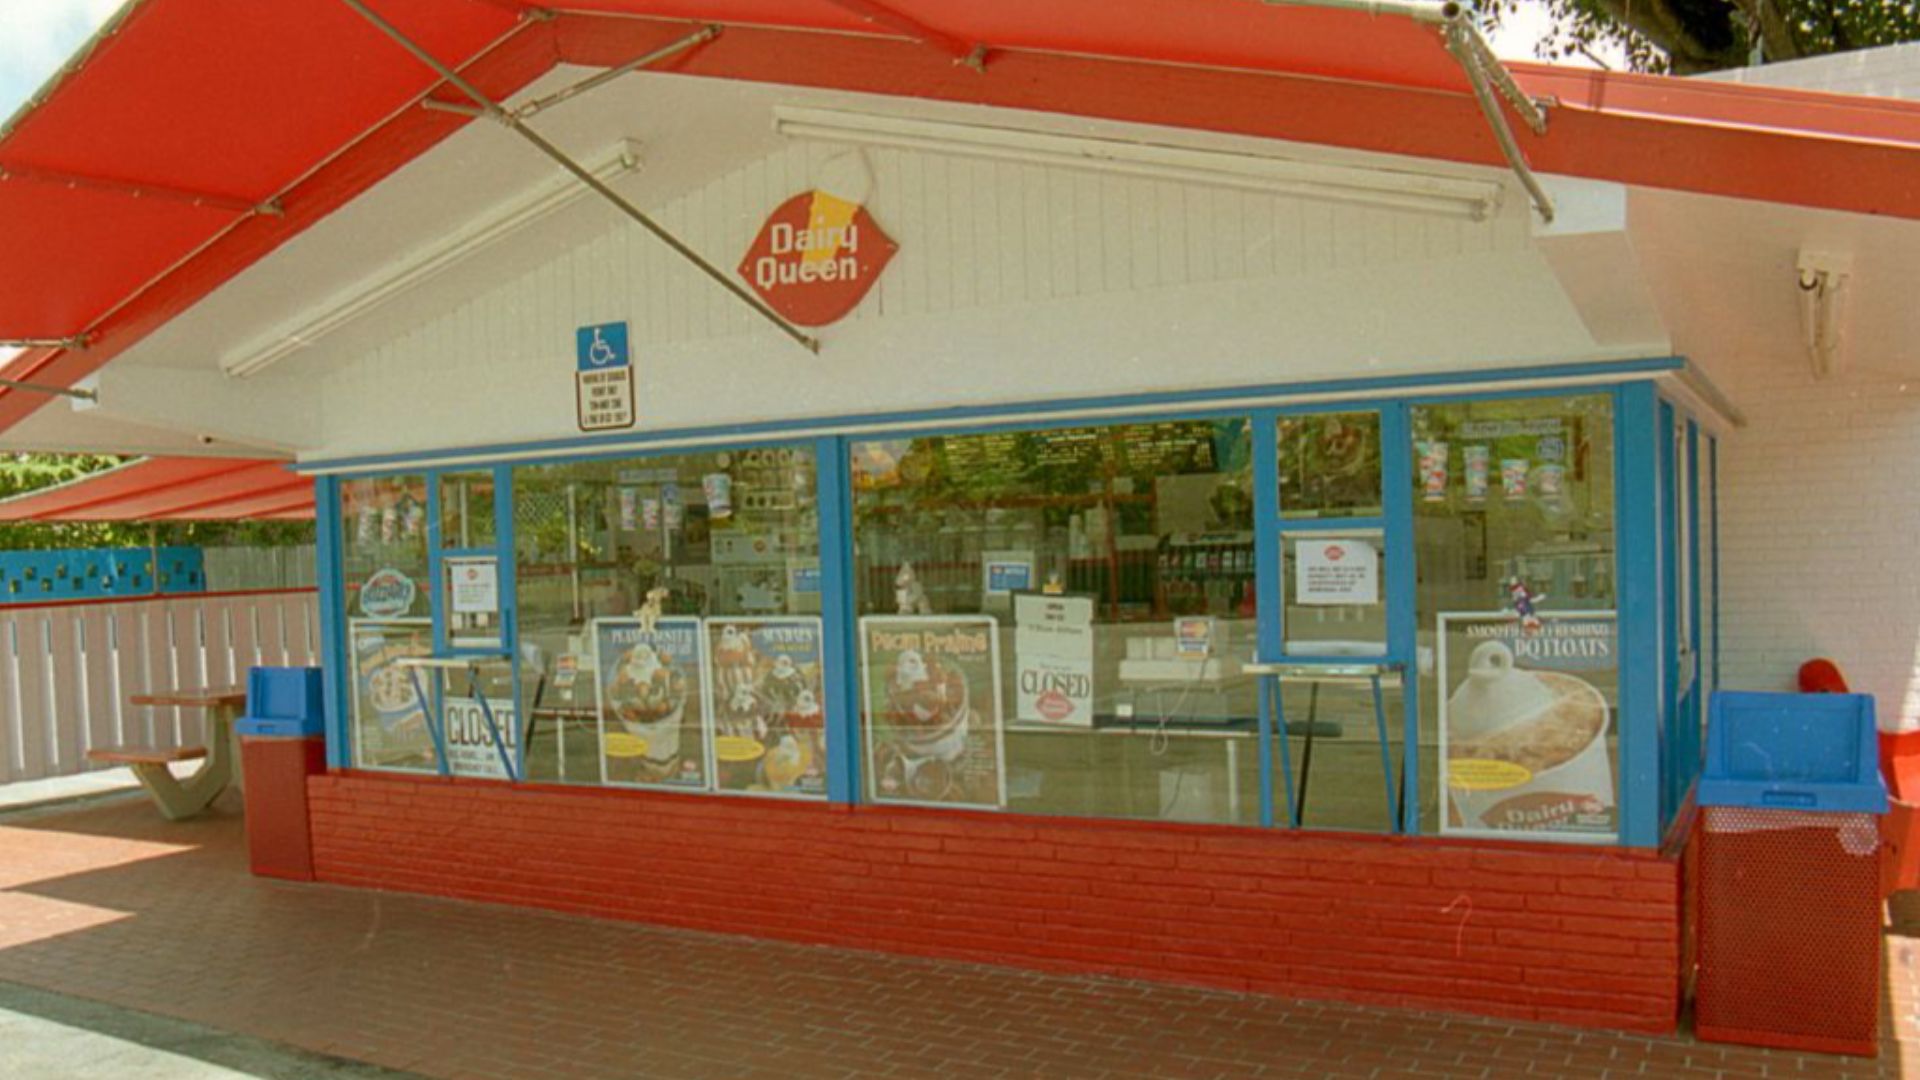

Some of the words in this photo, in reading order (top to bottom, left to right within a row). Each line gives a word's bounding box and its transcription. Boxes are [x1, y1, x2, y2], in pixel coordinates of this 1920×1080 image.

[771, 216, 858, 254] Dairy
[756, 257, 858, 290] Queen
[1021, 669, 1090, 698] CLOSED
